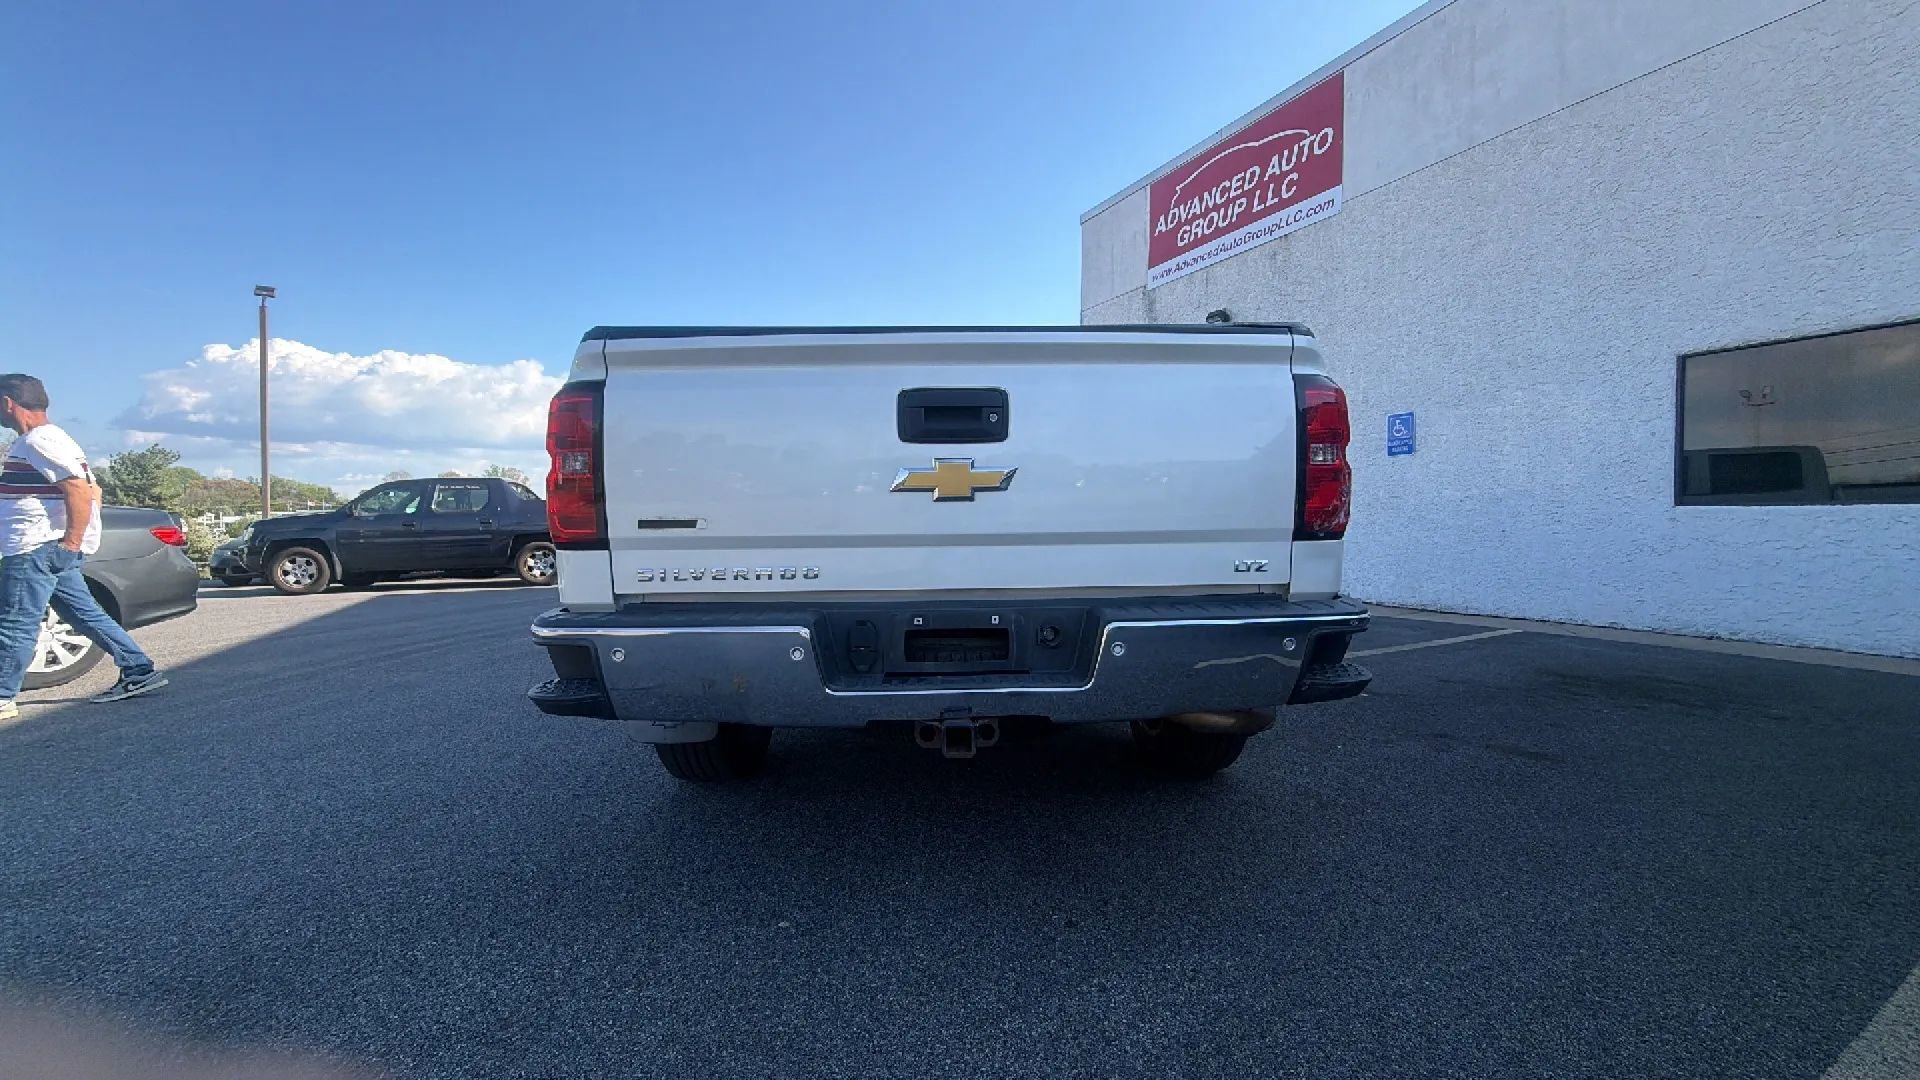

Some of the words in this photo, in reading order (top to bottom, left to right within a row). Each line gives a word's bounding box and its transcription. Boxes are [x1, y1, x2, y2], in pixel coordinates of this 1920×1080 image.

[1154, 165, 1261, 236] ADVANCED
[1263, 127, 1334, 181] AUTO
[1177, 198, 1248, 247] GROUP
[1252, 172, 1299, 213] LLC
[1152, 197, 1335, 282] www.AdvancedAutoGroupLLC.com
[637, 566, 820, 583] SILVERADO
[1233, 559, 1269, 573] LTZ
